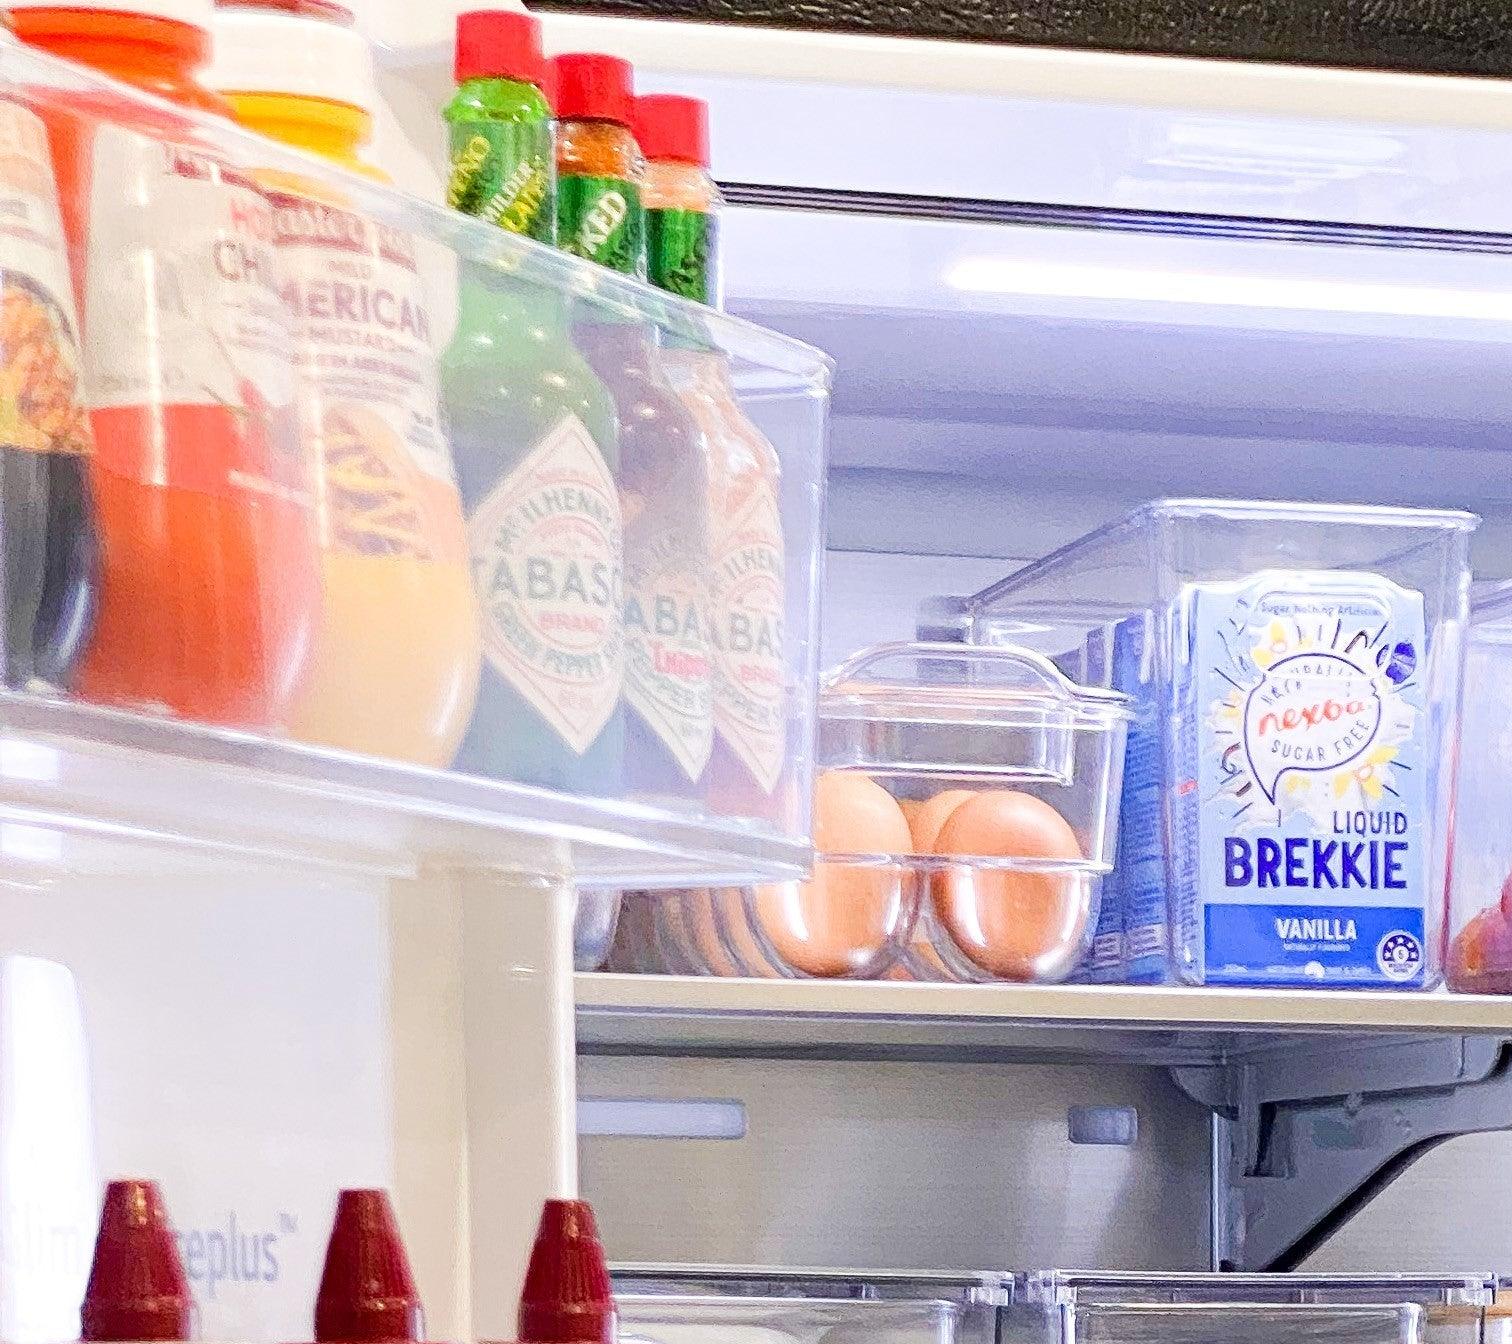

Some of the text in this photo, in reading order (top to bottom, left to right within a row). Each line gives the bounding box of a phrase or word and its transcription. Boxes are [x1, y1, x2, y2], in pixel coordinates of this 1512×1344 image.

[1272, 718, 1370, 761] SUGAR FREE
[1333, 810, 1409, 838] LIQUID
[1224, 837, 1409, 889] BREKKIE
[1275, 917, 1358, 941] VANILLA
